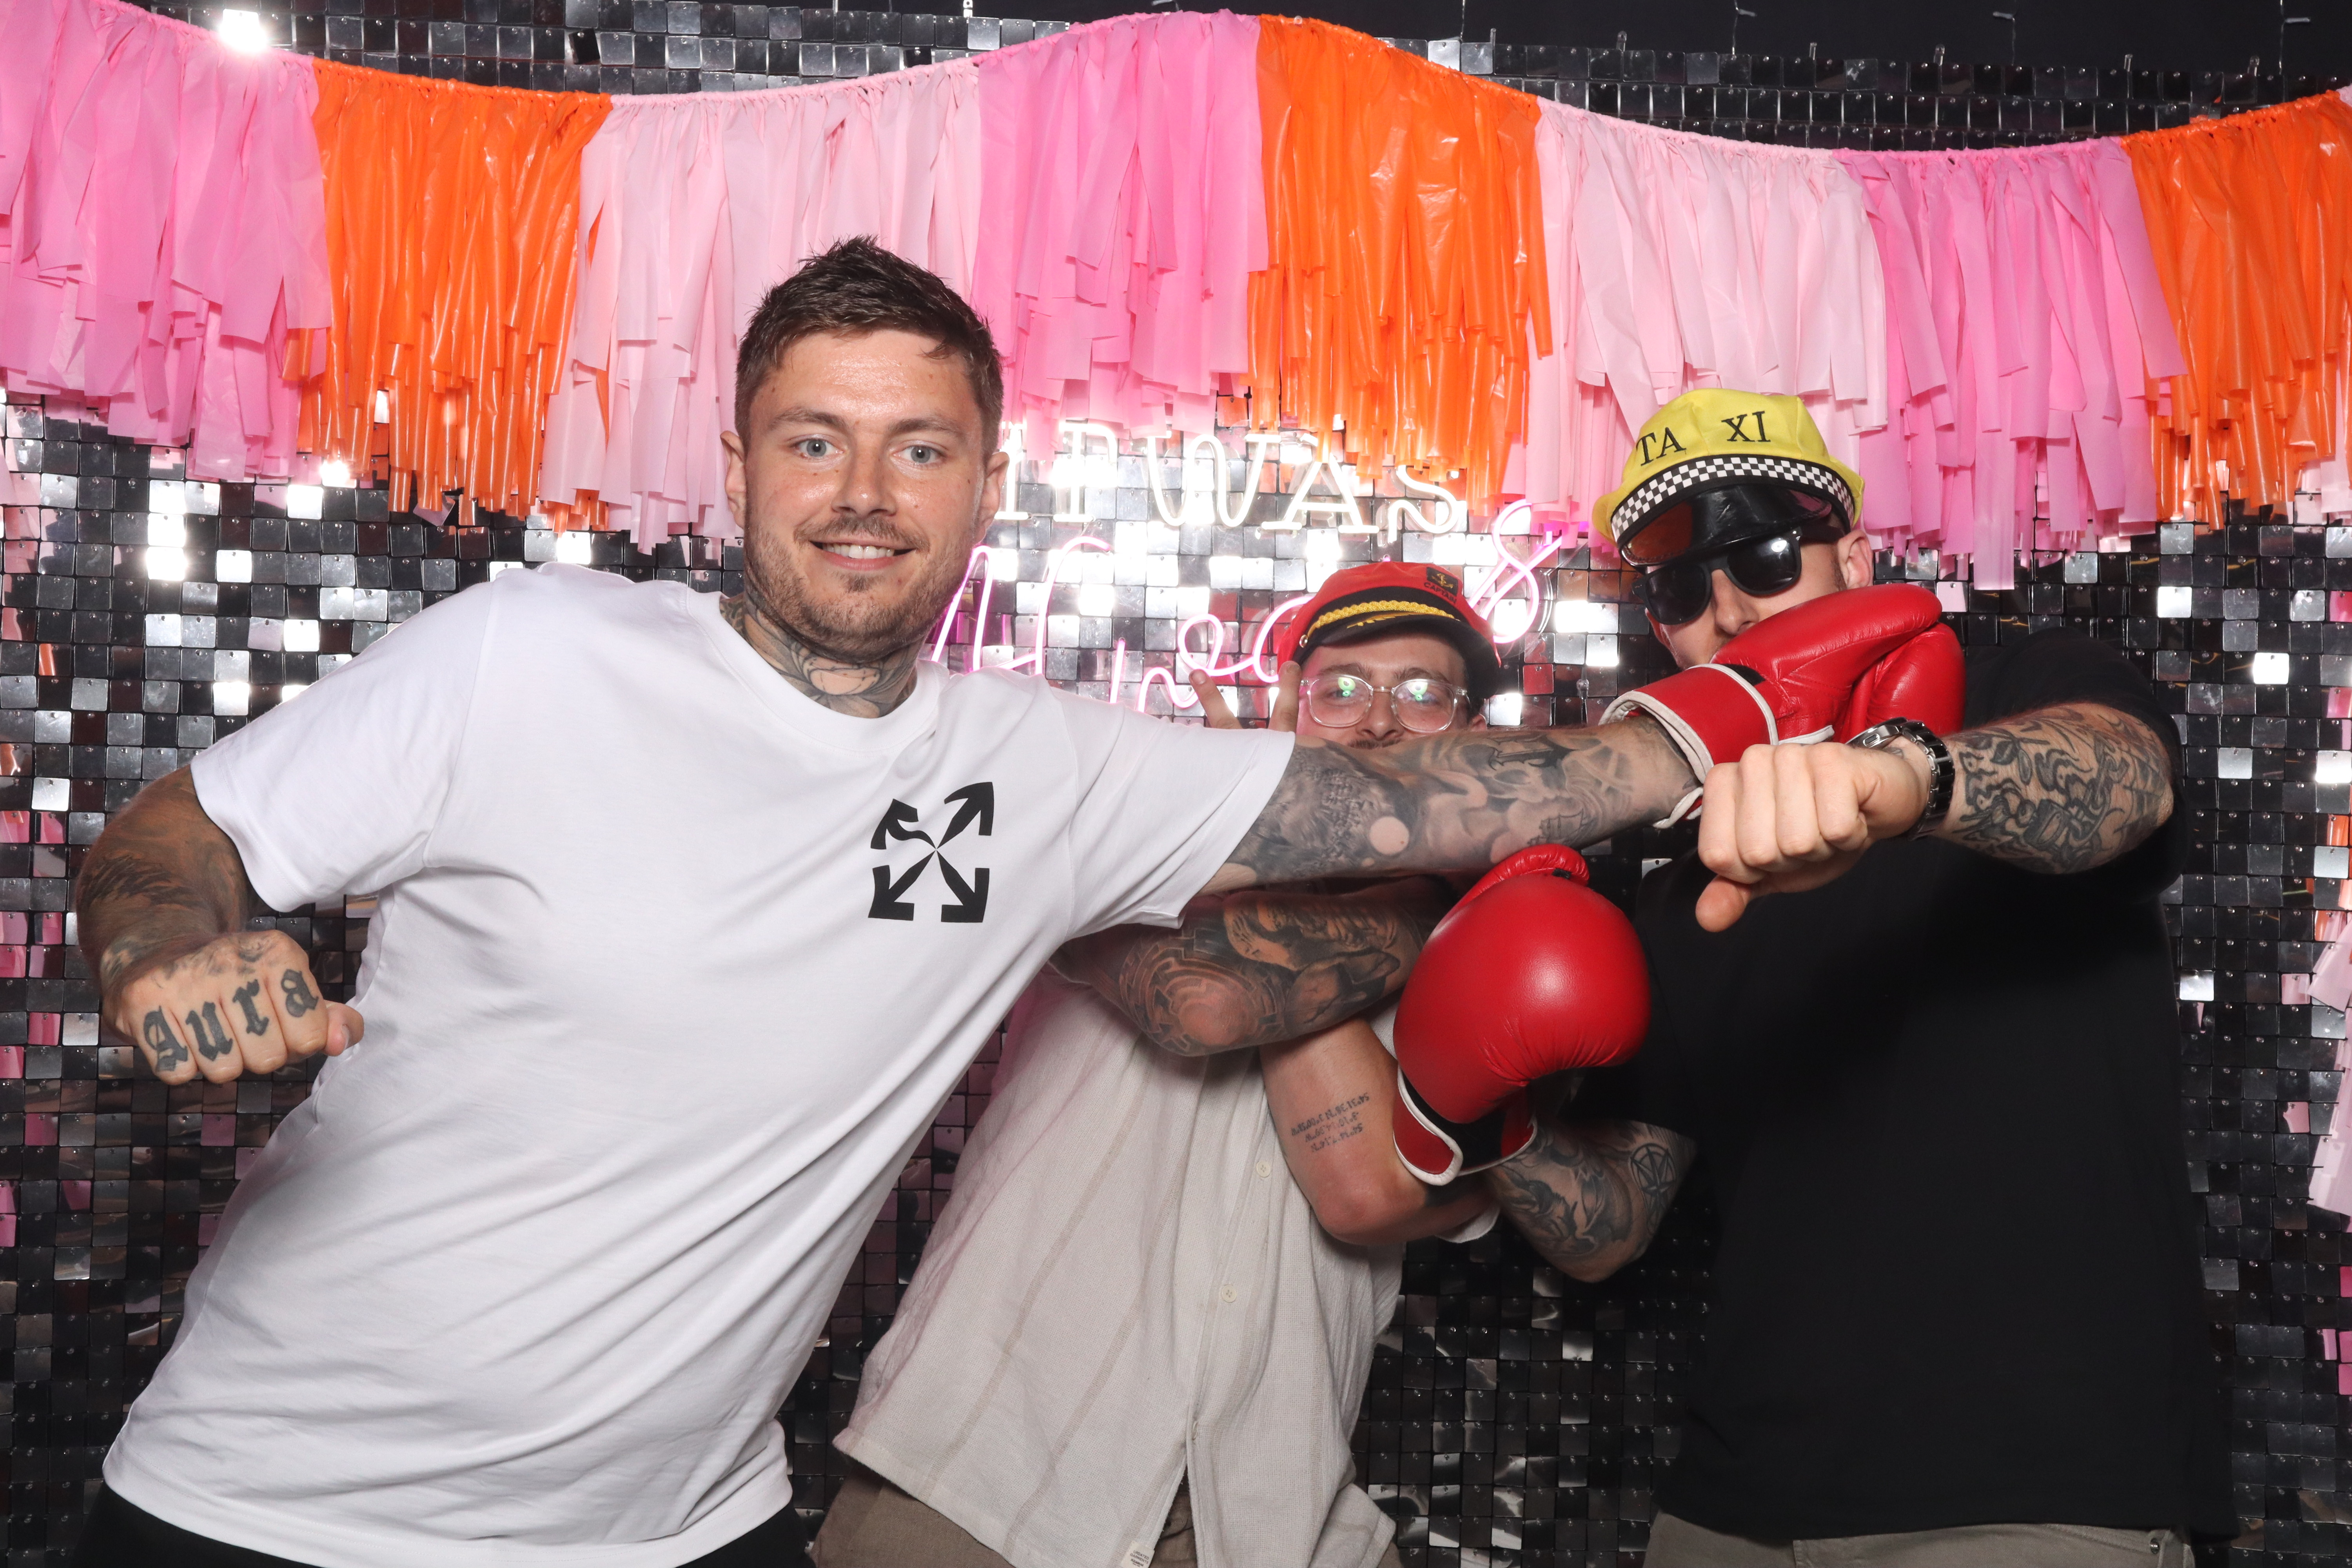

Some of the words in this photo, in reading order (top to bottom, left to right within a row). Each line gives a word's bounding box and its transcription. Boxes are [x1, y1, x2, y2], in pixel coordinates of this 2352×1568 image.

[1145, 430, 1464, 544] WAS
[1424, 582, 1457, 604] CAPTAIN
[1130, 1552, 1149, 1564] GARMENTS
[1133, 1550, 1149, 1560] UPDATED
